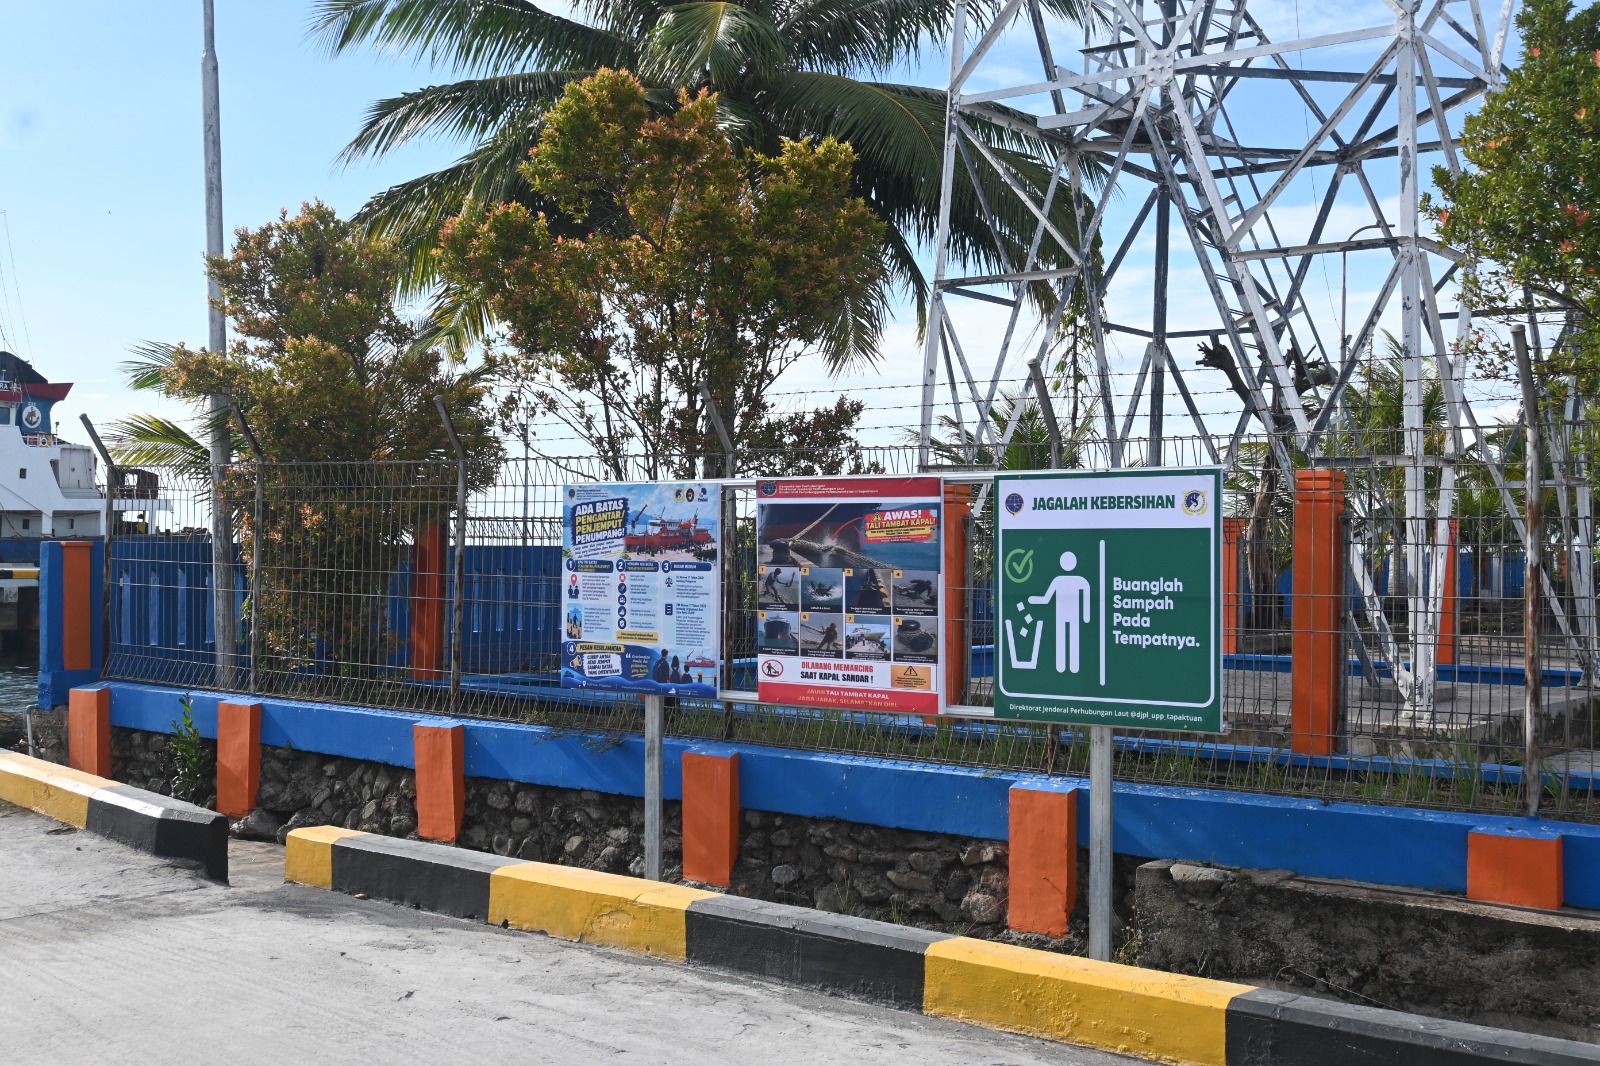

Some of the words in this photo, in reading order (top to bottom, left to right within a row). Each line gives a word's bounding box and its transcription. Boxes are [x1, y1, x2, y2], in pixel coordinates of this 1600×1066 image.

[575, 504, 594, 516] ADA
[596, 500, 624, 513] BATAS
[1032, 496, 1088, 510] JAGALAH
[1091, 495, 1175, 510] KEBERSIHAN
[576, 510, 625, 525] PENGANTAR/
[884, 510, 921, 520] AWAS!
[576, 519, 623, 535] PENJEMPUT
[576, 528, 624, 544] PENUMPANG!
[569, 560, 572, 568] 1
[664, 563, 668, 571] 3
[1113, 577, 1183, 595] Buanglah
[1113, 595, 1174, 612] Sampah
[1113, 613, 1150, 627] Pada
[1113, 630, 1200, 650] Tempatnya.
[801, 661, 831, 670] DILARANG
[833, 664, 873, 672] MEMANCING
[800, 671, 817, 680] SAAT
[819, 672, 840, 681] KAPAL
[842, 674, 869, 683] SANDAR
[1070, 708, 1112, 717] Perhubungan
[1131, 711, 1202, 722] @djpl_upp_tapaktuan
